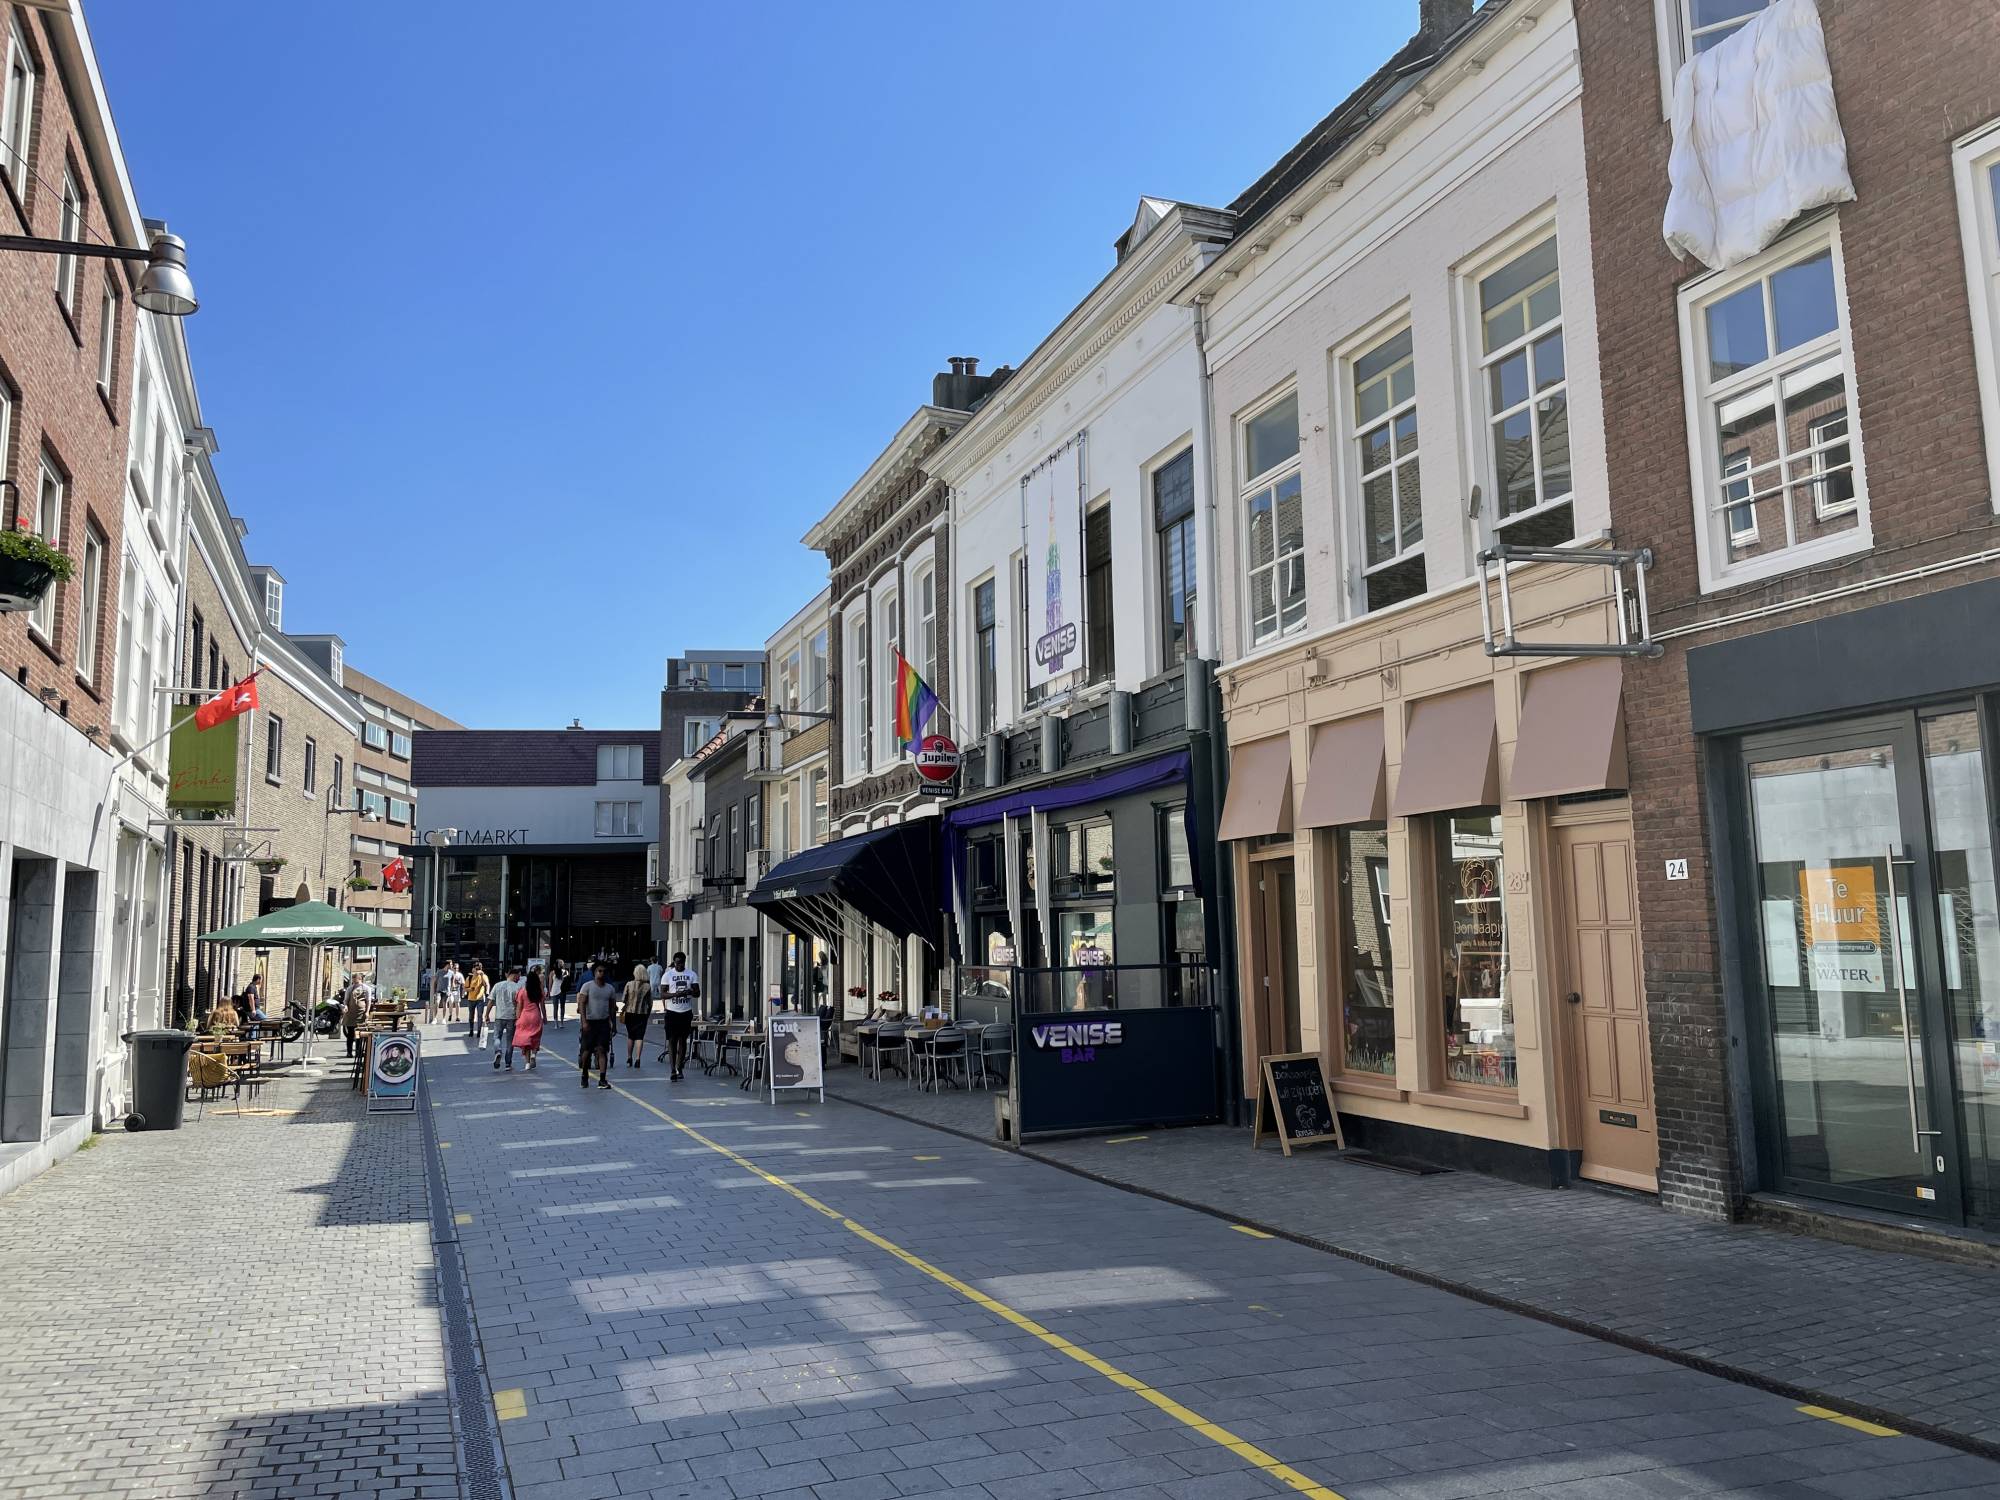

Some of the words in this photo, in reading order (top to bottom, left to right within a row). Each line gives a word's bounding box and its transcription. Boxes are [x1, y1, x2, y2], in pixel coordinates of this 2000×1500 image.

[1037, 625, 1075, 661] VENISE
[921, 753, 957, 763] Jupiler
[410, 828, 530, 846] HOTMARKT
[1669, 861, 1685, 878] 24
[1825, 878, 1848, 899] Te
[1814, 903, 1866, 924] Huur
[993, 949, 1014, 963] VENISE
[1076, 950, 1104, 966] VENISE
[1817, 968, 1873, 984] WATER
[1032, 1022, 1123, 1048] VENISE
[1060, 1048, 1096, 1063] BAR
